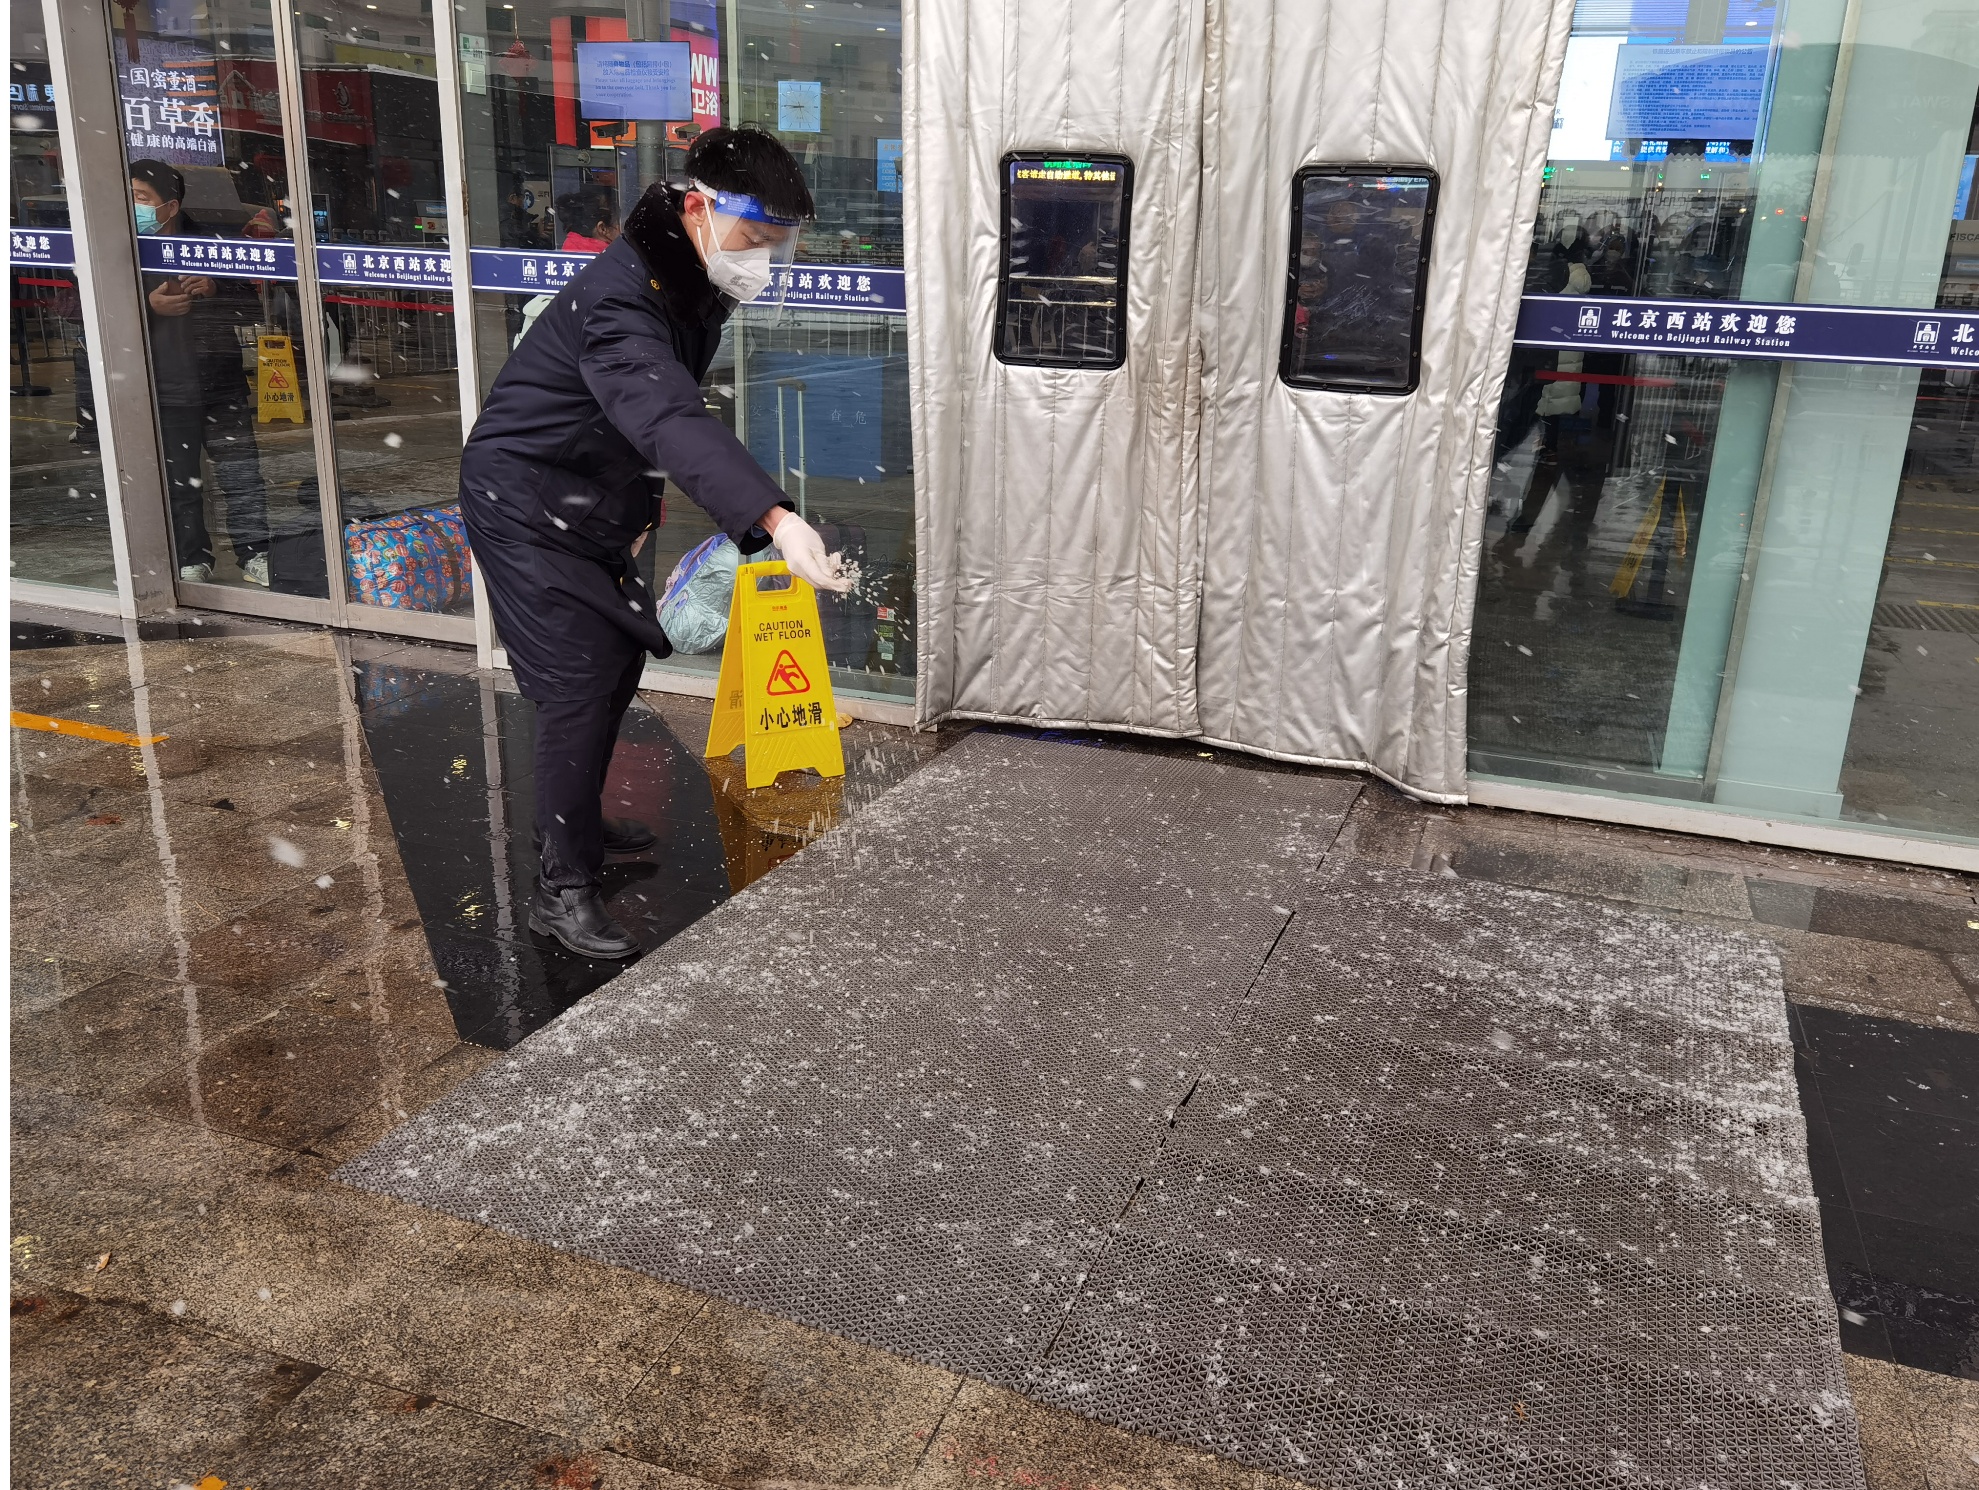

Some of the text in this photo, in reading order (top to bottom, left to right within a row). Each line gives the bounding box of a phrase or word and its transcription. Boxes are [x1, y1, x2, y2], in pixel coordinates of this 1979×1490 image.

[130, 67, 196, 93] 国密董酒
[692, 88, 718, 117] 卫浴
[121, 95, 215, 137] 百草香
[126, 131, 217, 153] 健康的高端白酒
[12, 235, 50, 250] 欢迎您
[180, 244, 276, 262] 北京西站欢迎您
[181, 260, 203, 268] Welcome
[210, 262, 234, 270] Beijingxi
[235, 263, 255, 271] Railway
[364, 271, 387, 279] Welcome
[396, 272, 421, 281] Beijingxi
[423, 274, 445, 283] Railway
[815, 292, 841, 302] Railway
[844, 294, 870, 302] Station
[1611, 308, 1976, 343] 北京西站欢迎您 北
[1611, 330, 1650, 341] Welcome
[1653, 333, 1663, 341] to
[1666, 333, 1710, 344] Beijingxi
[1713, 335, 1751, 347] Railway
[1755, 337, 1791, 347] Station
[264, 391, 294, 402] 小心地滑
[759, 619, 804, 632] CAUTION
[753, 629, 811, 642] WET FLOOR
[760, 701, 822, 731] 小心地滑
